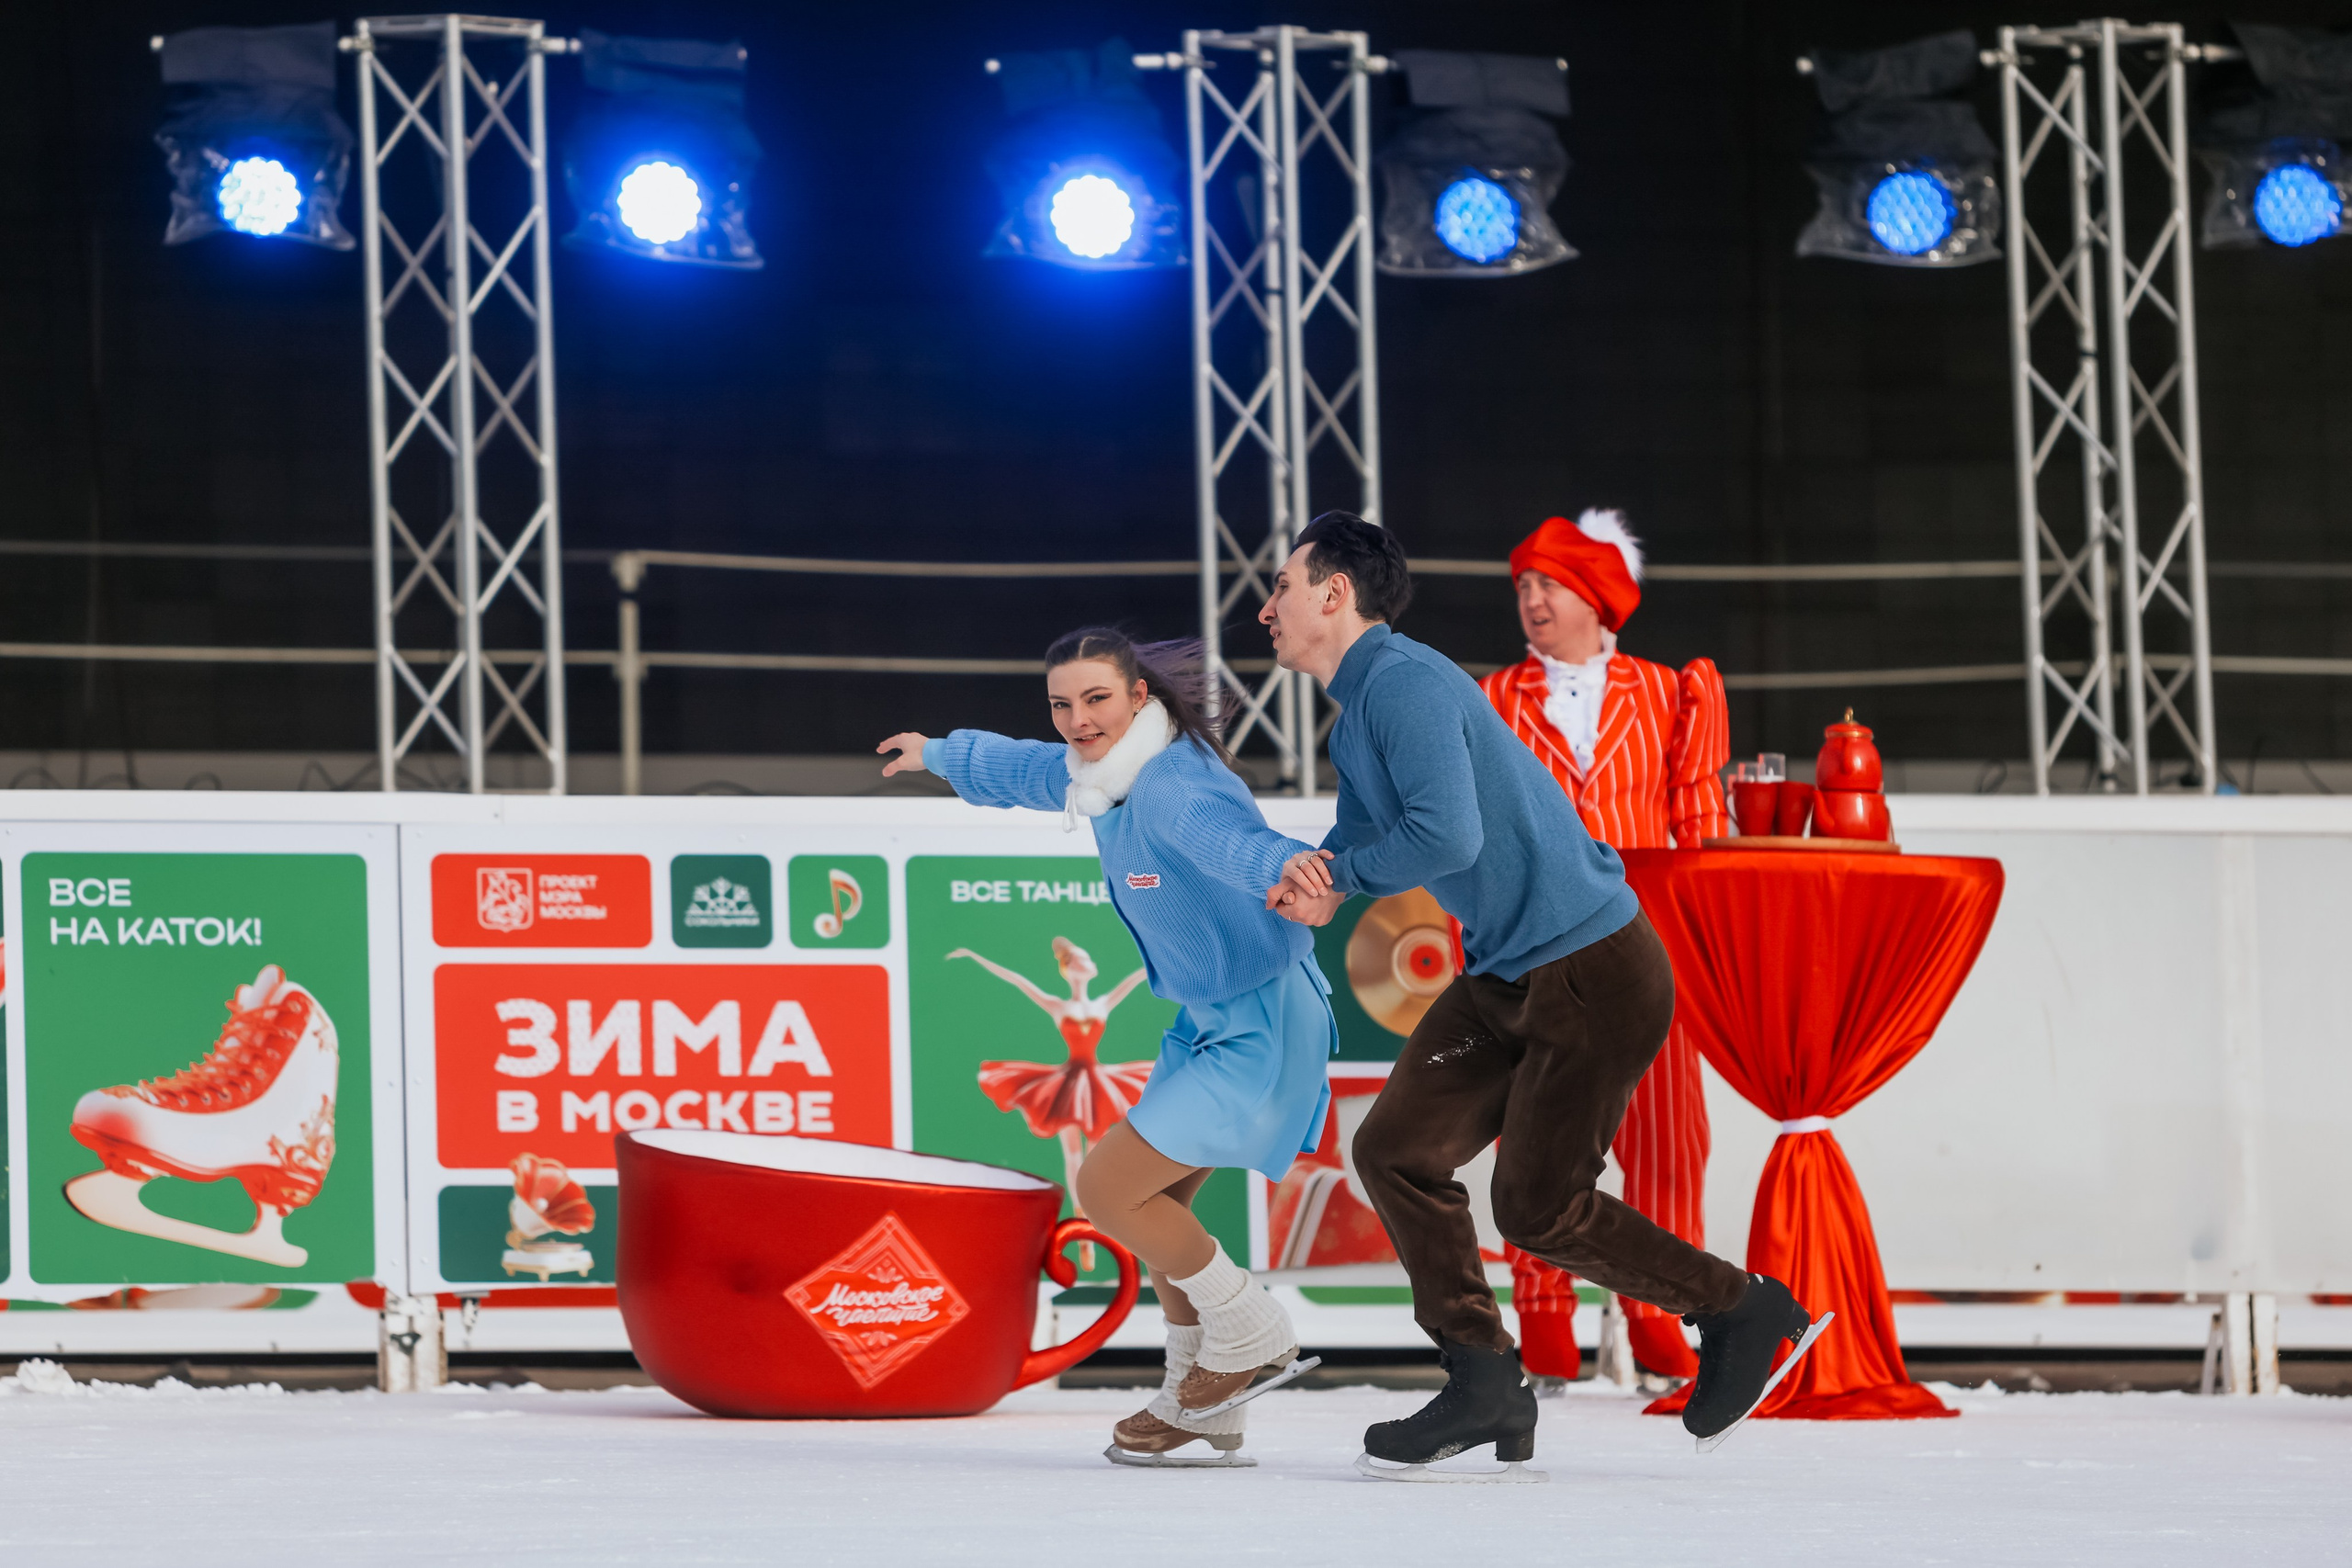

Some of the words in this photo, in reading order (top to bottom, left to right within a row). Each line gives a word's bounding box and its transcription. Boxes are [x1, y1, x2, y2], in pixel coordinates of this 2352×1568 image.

[49, 878, 132, 907] ВСЕ
[538, 874, 598, 889] ПРОЕКТ
[951, 880, 1012, 903] ВСЕ
[538, 890, 583, 904] МЭРА
[539, 905, 608, 919] МОСКВЫ
[50, 917, 110, 945] НА
[118, 917, 263, 946] КАТОК!
[494, 998, 833, 1077] ЗИМА
[496, 1090, 539, 1133] В
[560, 1090, 834, 1133] МОСКВЕ
[809, 1281, 944, 1314] Московское
